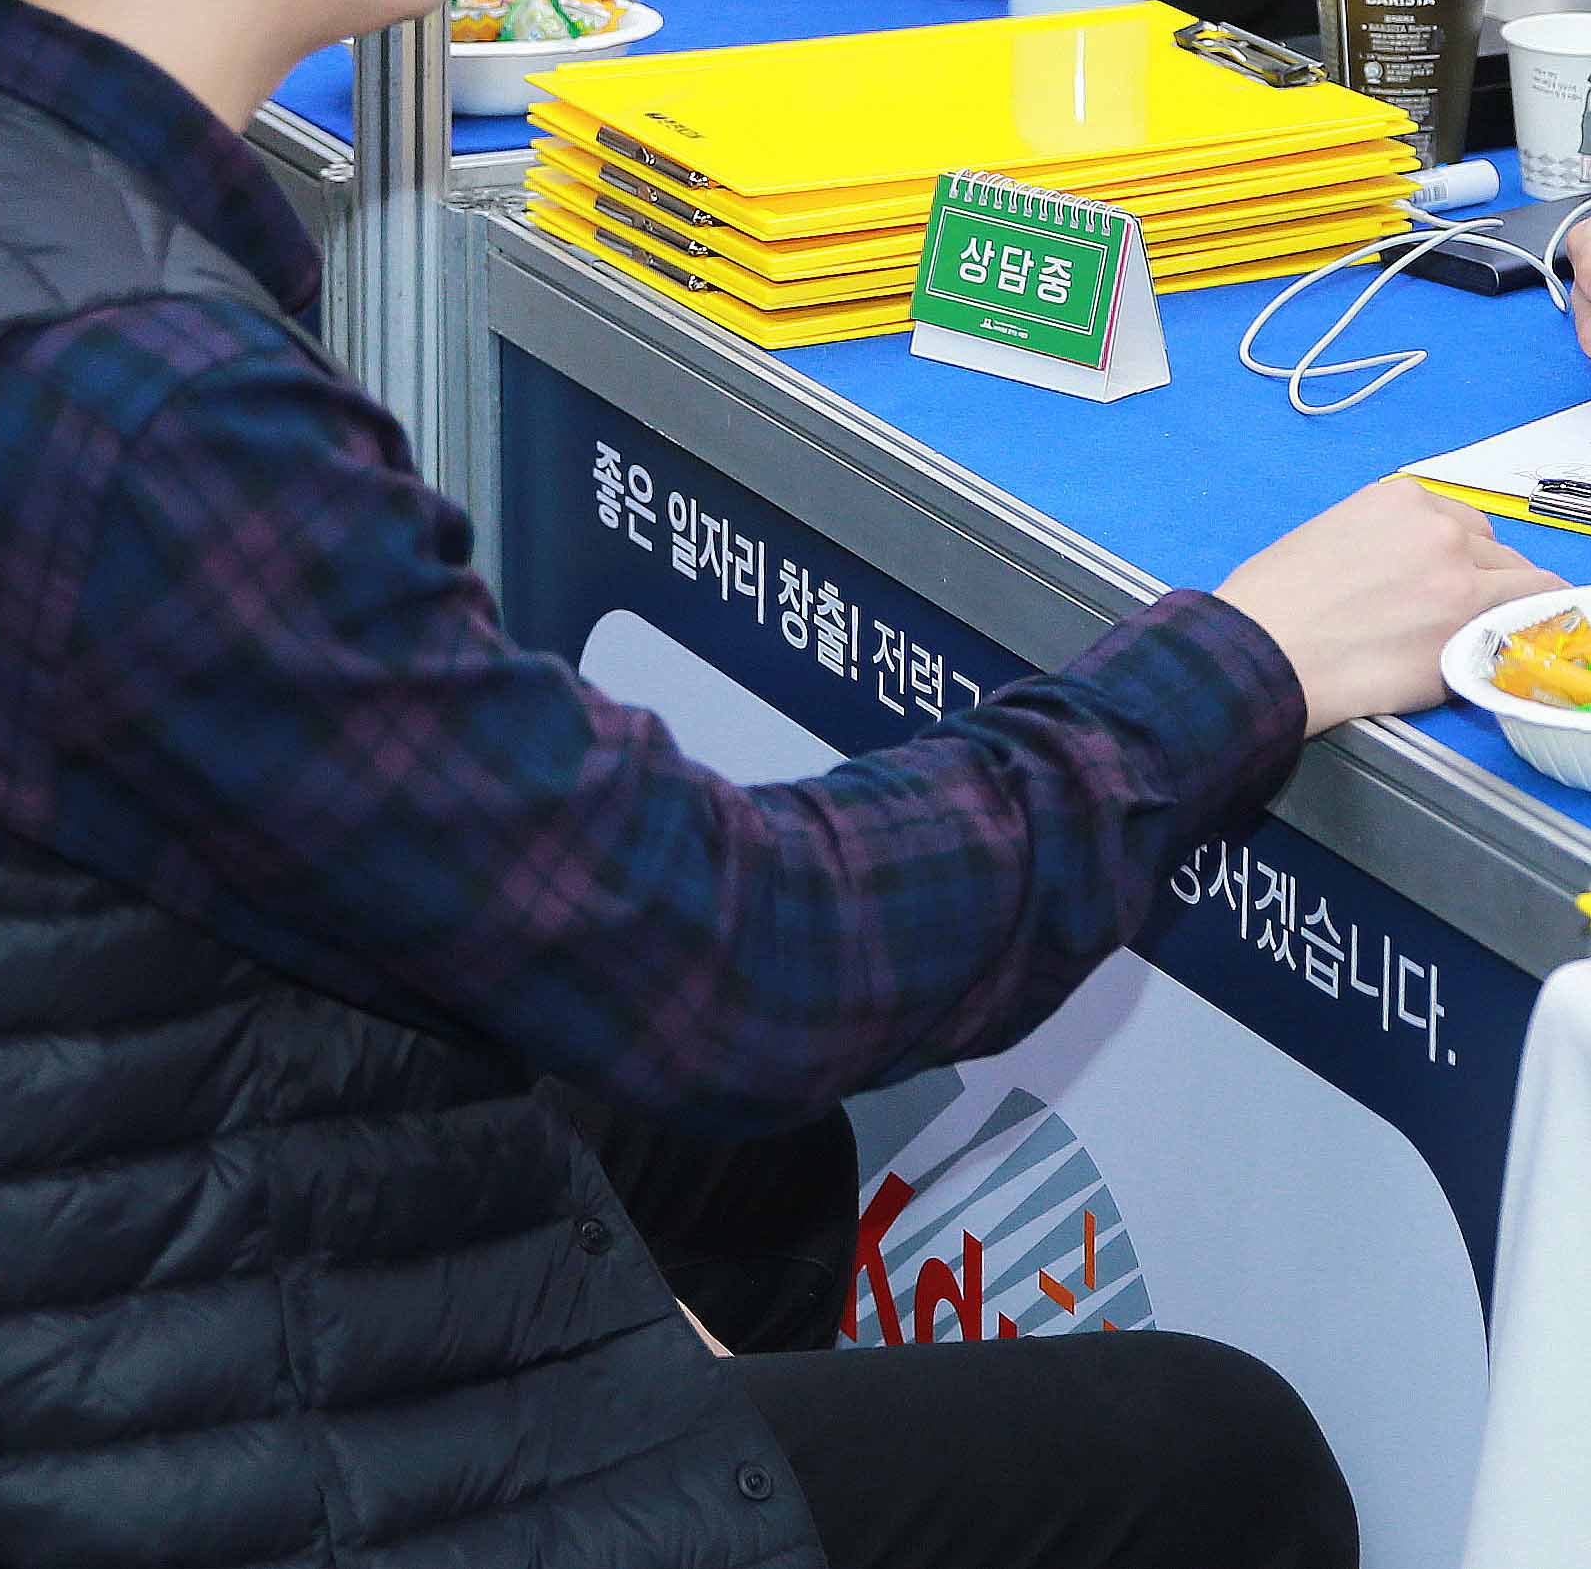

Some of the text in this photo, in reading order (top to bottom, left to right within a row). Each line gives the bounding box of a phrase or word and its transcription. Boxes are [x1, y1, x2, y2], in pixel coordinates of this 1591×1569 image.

[959, 236, 1076, 305] 상담중
[592, 439, 981, 723] 좋은 일자리 창출! 전력
[840, 1171, 1019, 1347] Kd
